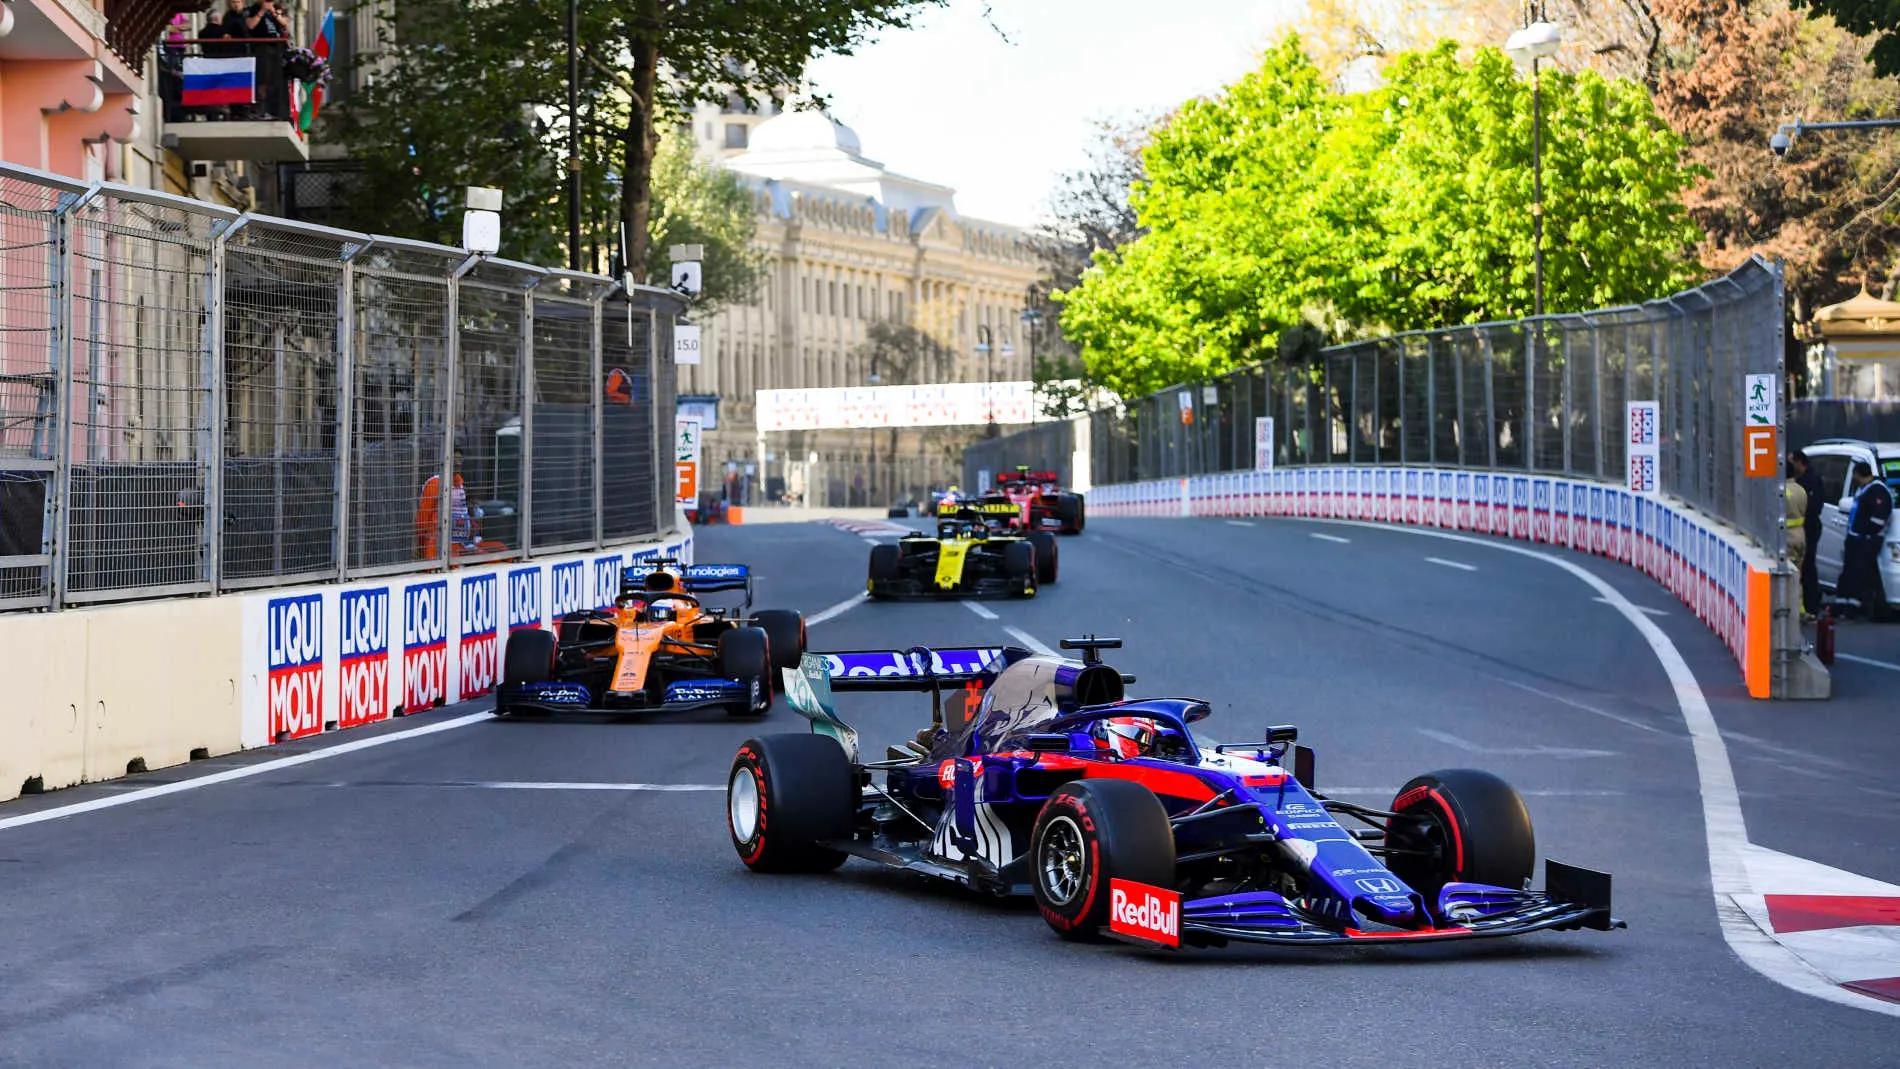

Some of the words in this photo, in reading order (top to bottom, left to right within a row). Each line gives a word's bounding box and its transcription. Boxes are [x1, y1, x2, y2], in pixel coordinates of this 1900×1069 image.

[1749, 431, 1771, 471] F
[675, 465, 692, 496] F
[405, 586, 447, 645] LIQUI
[462, 579, 496, 634] LIQUI
[509, 572, 541, 625] LIQUI
[553, 564, 584, 616] LIQUI
[270, 601, 321, 666] LIQUI
[342, 594, 388, 655] LIQUI
[342, 658, 388, 722] MOLY
[404, 647, 447, 709] MOLY
[461, 637, 497, 695] MOLY
[270, 669, 322, 737] MOLY
